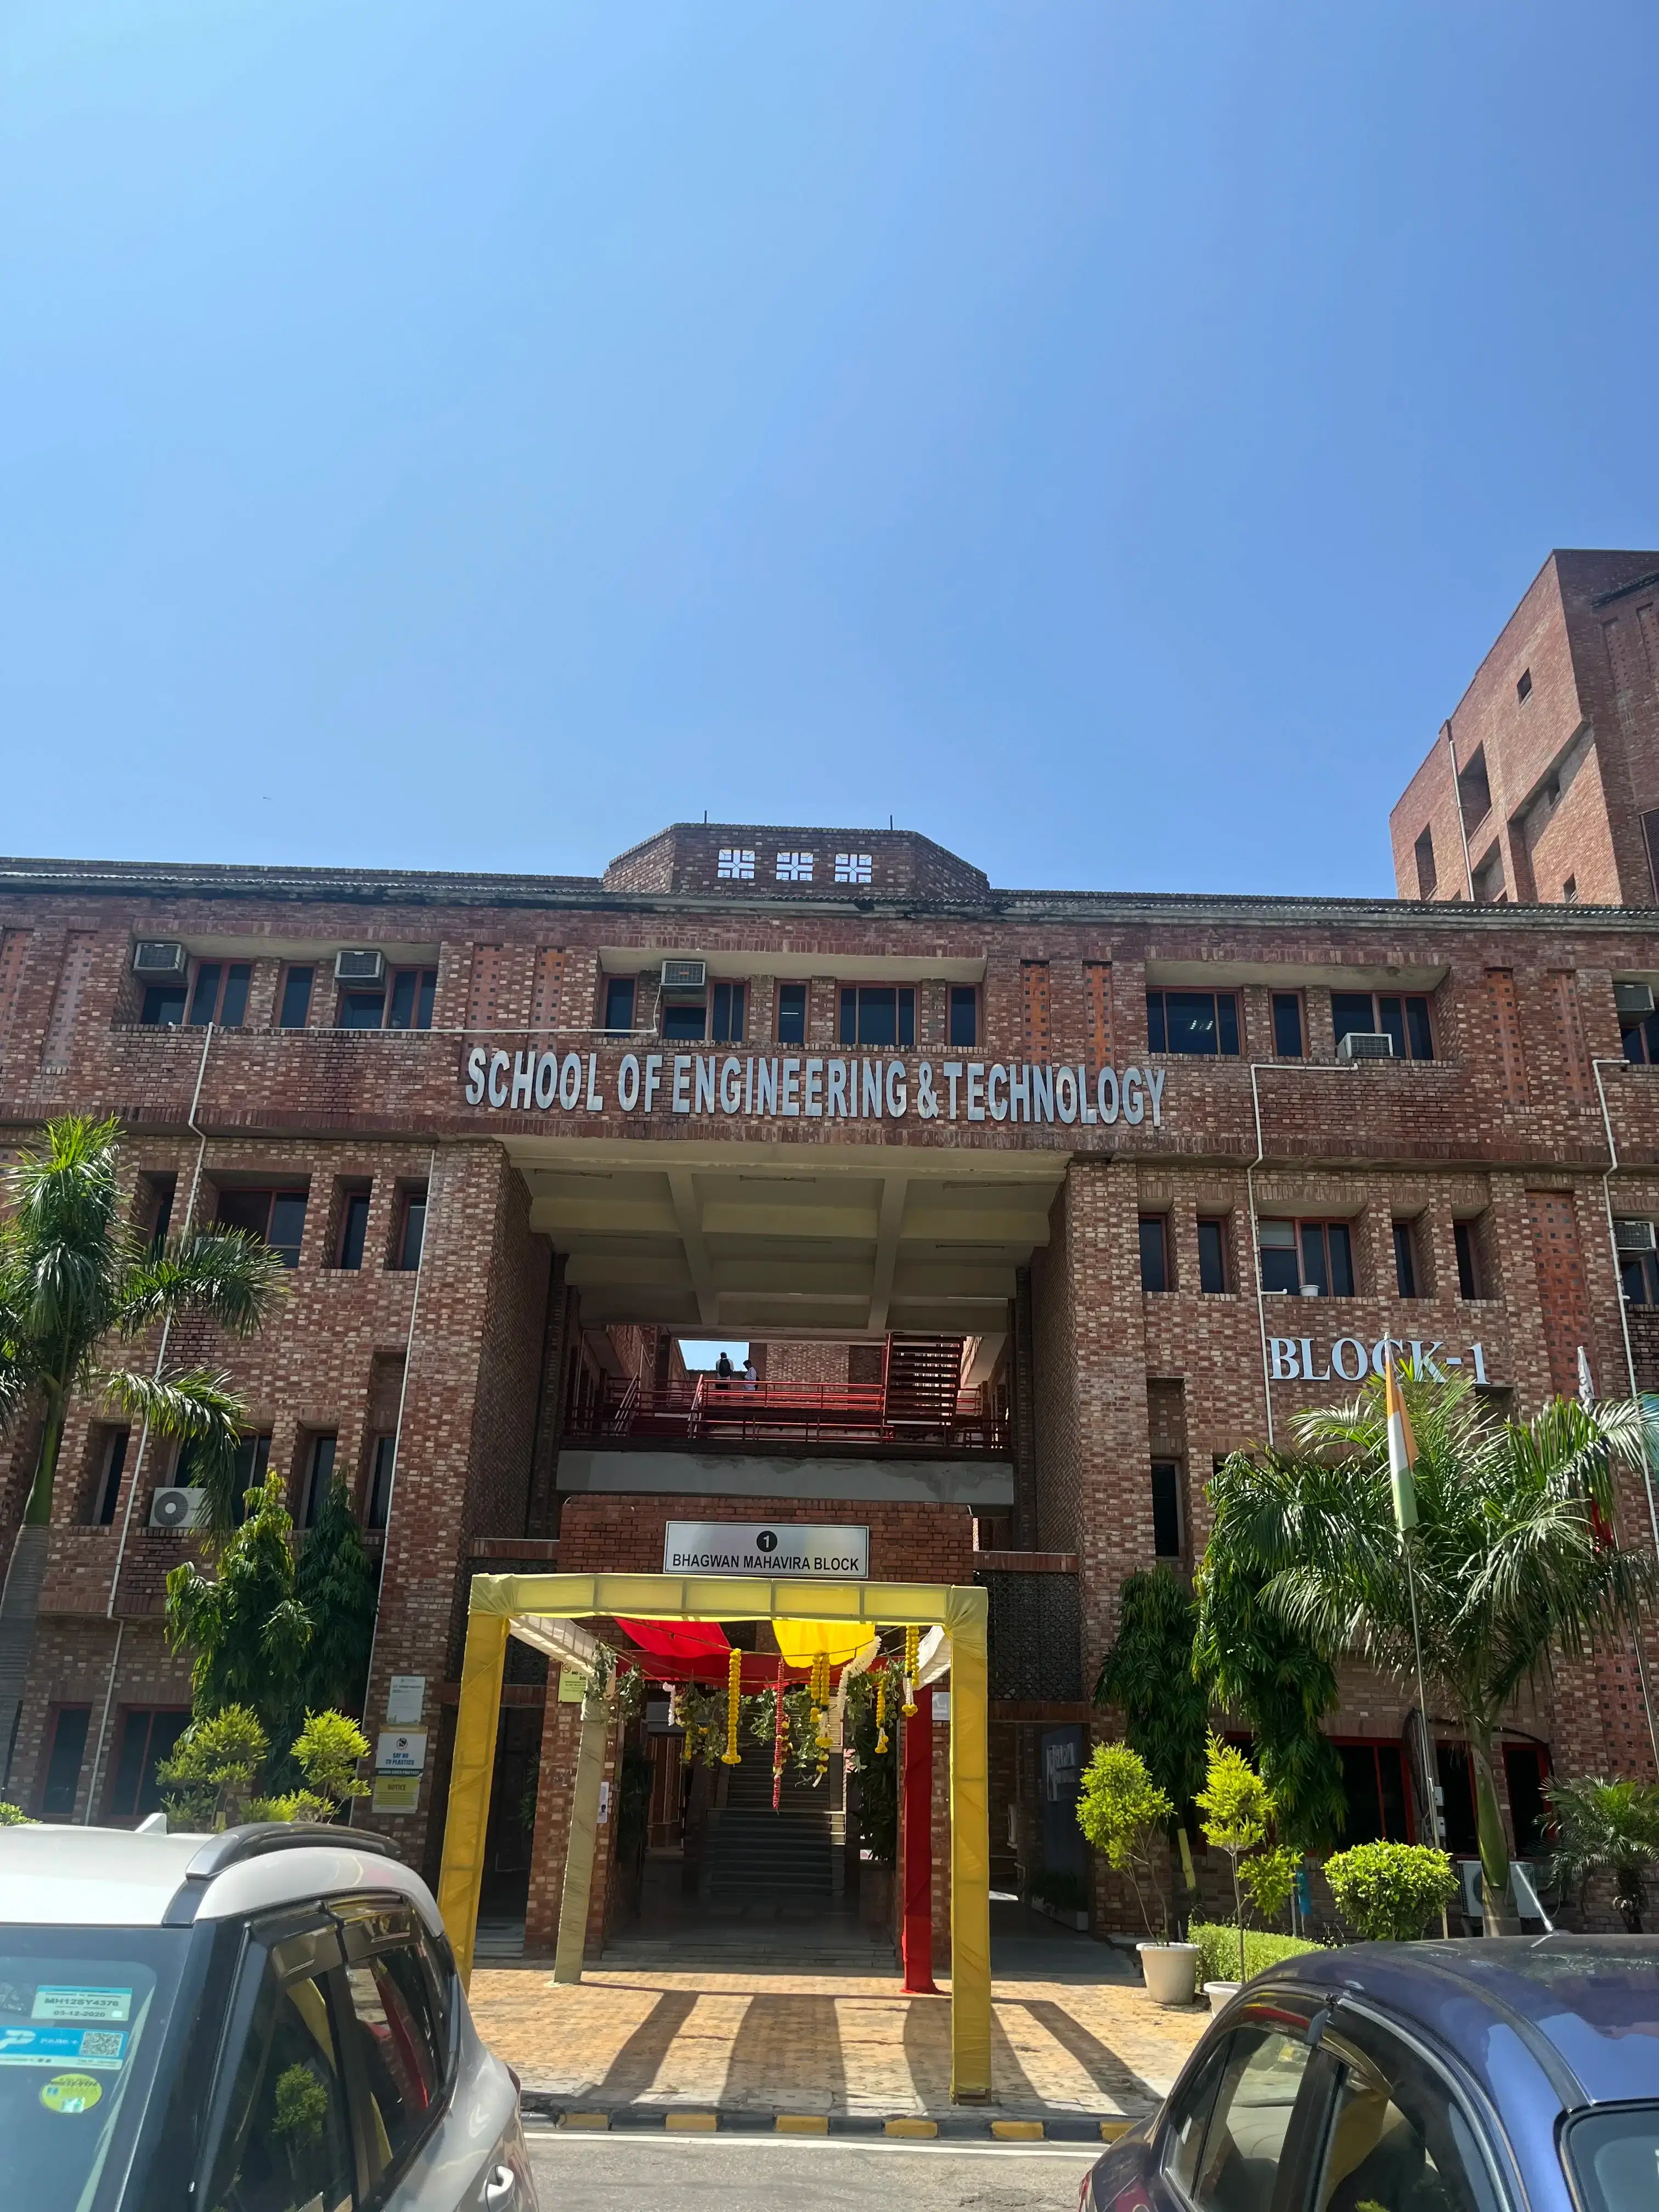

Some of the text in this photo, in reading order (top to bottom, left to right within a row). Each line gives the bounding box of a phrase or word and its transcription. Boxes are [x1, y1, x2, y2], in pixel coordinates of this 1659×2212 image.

[465, 1047, 603, 1111] SCHOOL
[617, 1053, 663, 1113] OF
[672, 1054, 907, 1119] ENGINEERING
[763, 1535, 770, 1548] 1
[672, 1554, 859, 1571] BHAGWAN MAHAVIRA BLOCK
